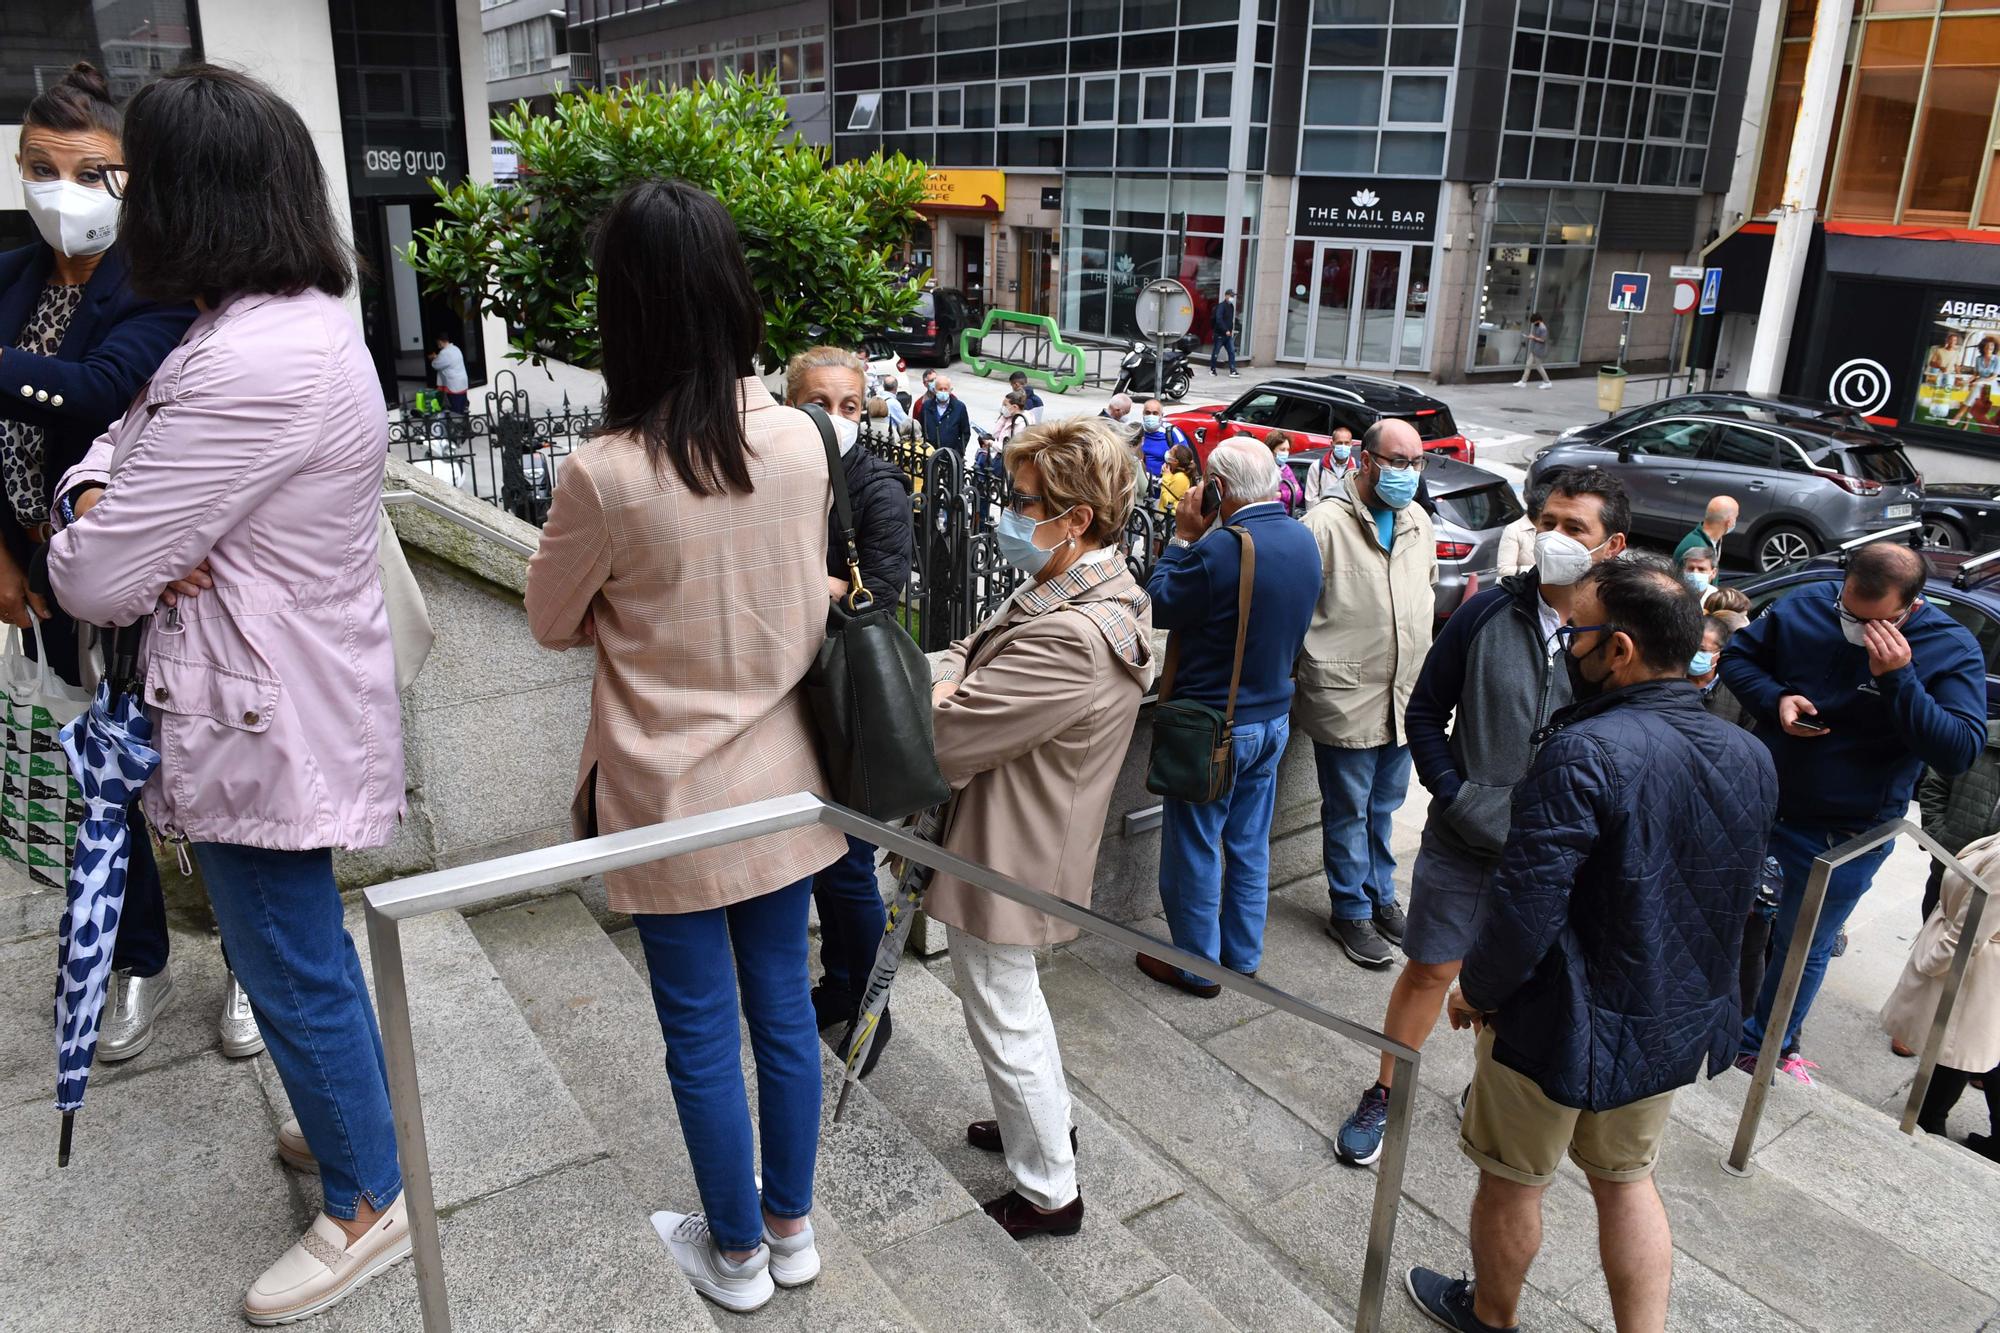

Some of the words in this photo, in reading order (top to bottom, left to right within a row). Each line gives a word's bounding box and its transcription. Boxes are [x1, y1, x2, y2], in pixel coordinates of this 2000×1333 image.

[366, 150, 401, 171] ase
[404, 150, 446, 176] grup
[1308, 207, 1339, 220] THE
[1346, 208, 1384, 222] NAIL
[1391, 210, 1425, 223] BAR
[1940, 300, 2000, 318] ABIER
